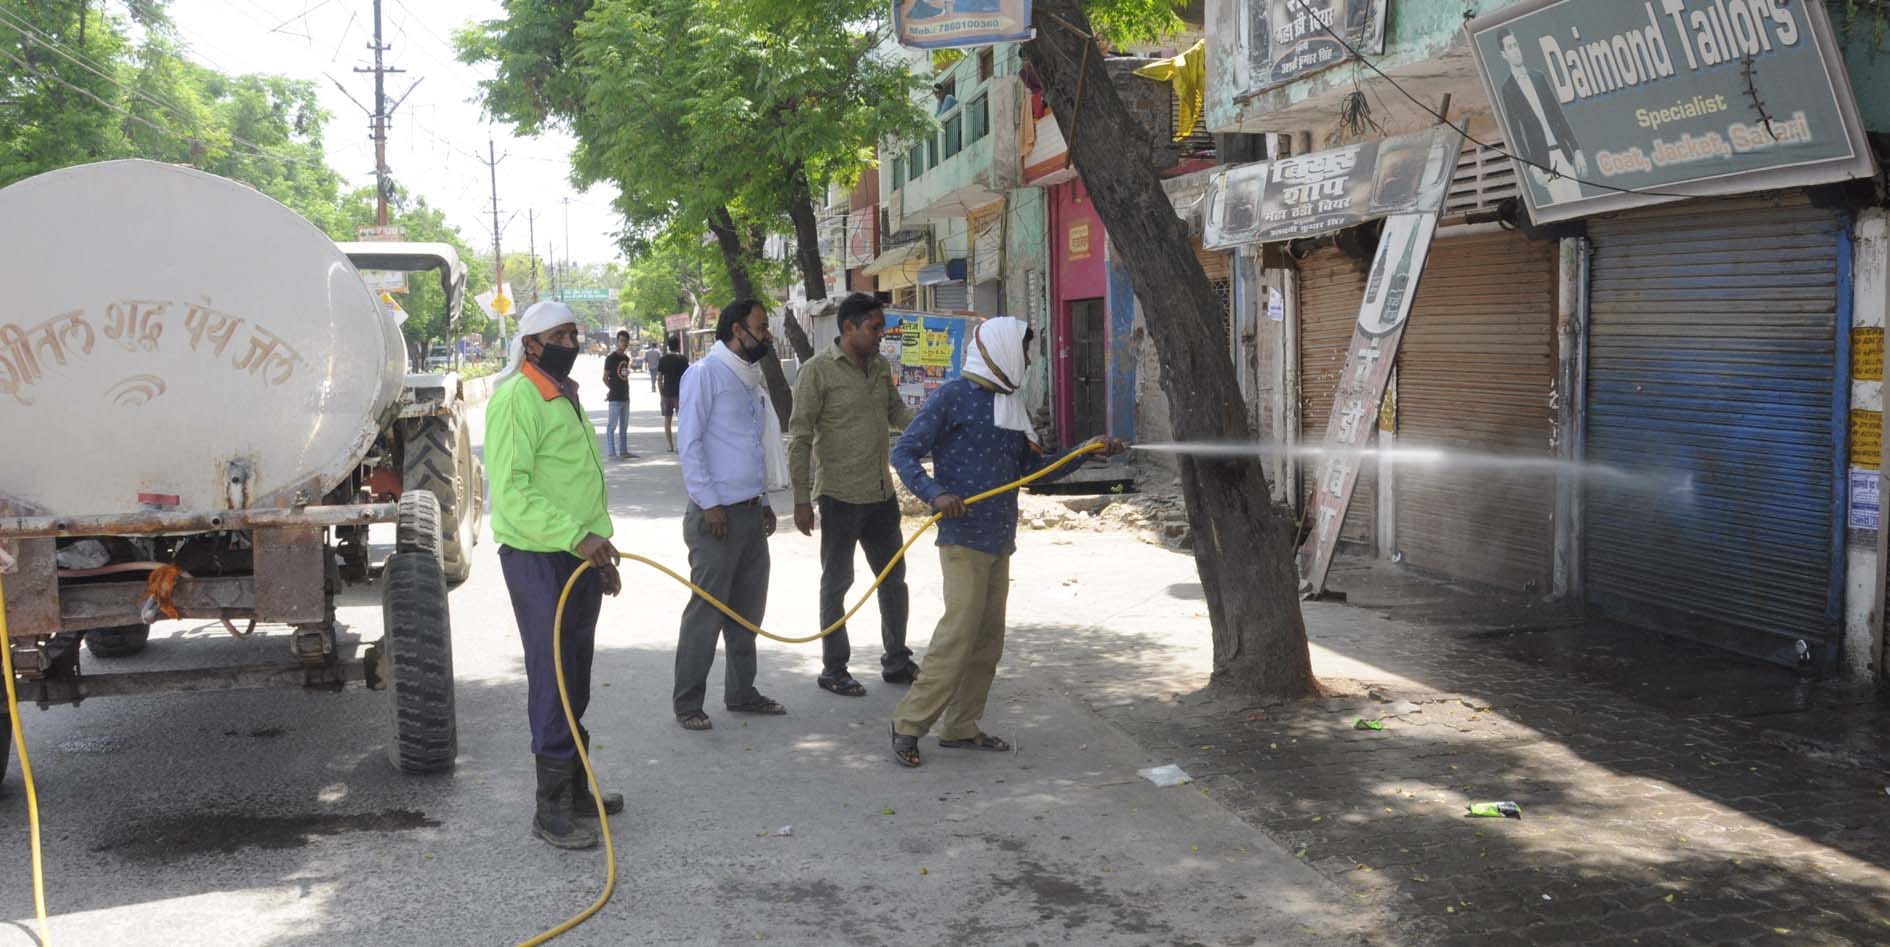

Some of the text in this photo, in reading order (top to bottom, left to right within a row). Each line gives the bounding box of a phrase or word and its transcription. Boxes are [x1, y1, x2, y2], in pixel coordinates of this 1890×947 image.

[1538, 0, 1800, 104] Daimond Tailors
[1597, 110, 1812, 177] Coat, Jacket, Safari
[1635, 94, 1728, 130] Specialist
[232, 324, 305, 388] जल
